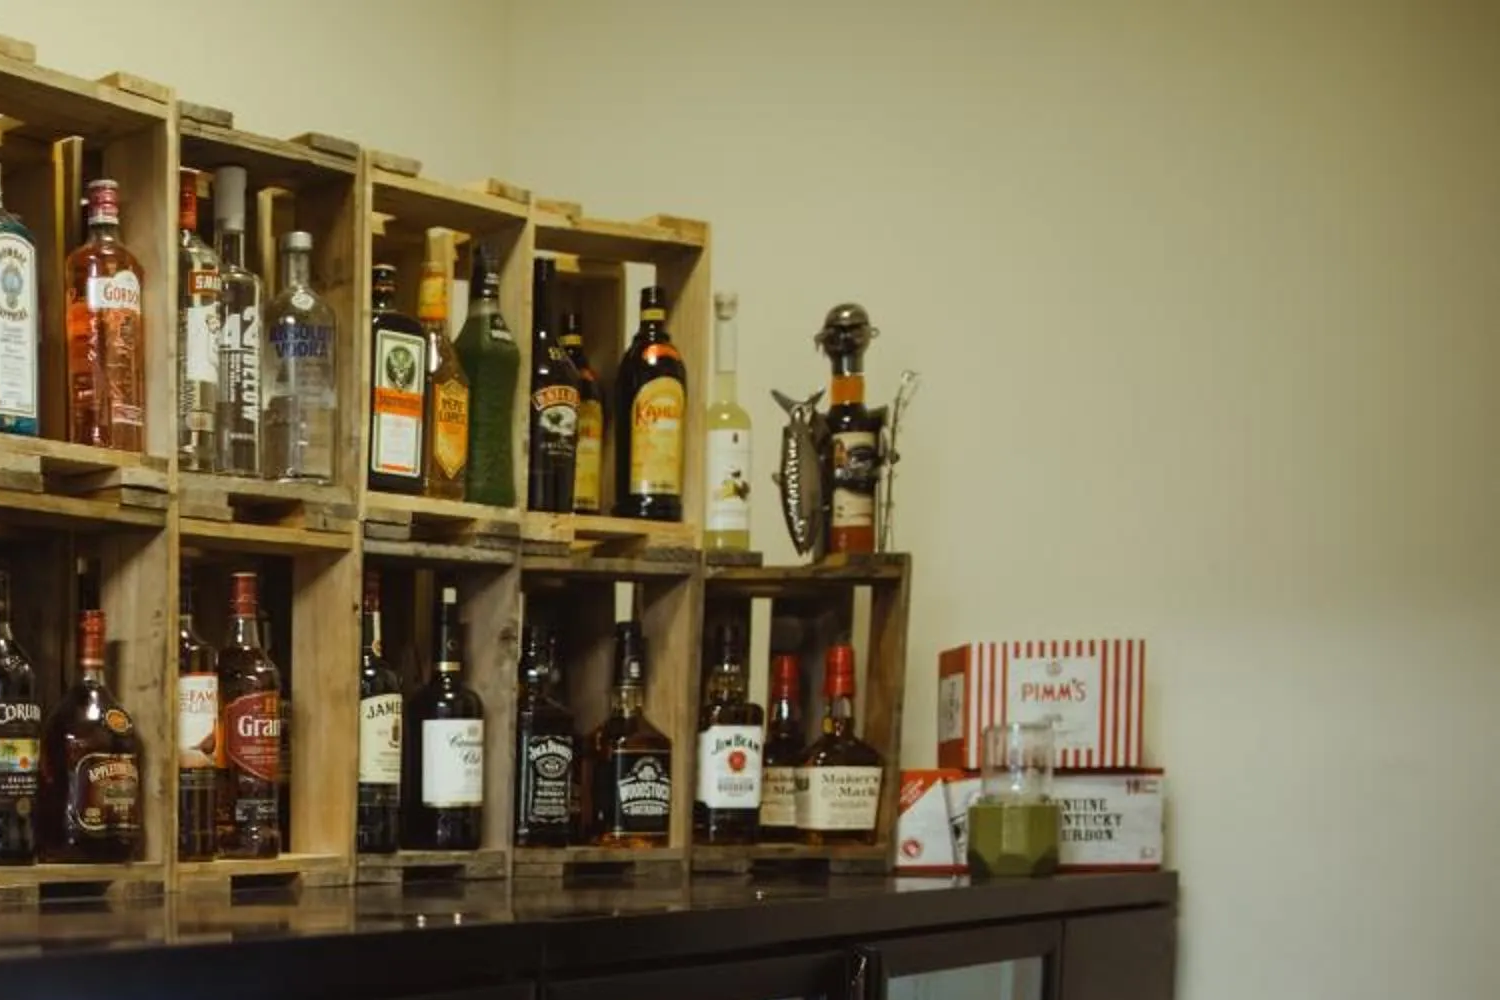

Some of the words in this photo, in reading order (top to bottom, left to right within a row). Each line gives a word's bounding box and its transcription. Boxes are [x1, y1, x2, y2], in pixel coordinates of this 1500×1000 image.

[1021, 681, 1087, 702] PIMM'S
[1060, 799, 1107, 812] NUINE
[1060, 814, 1123, 828] NTUCKY
[1061, 829, 1114, 843] URBON
